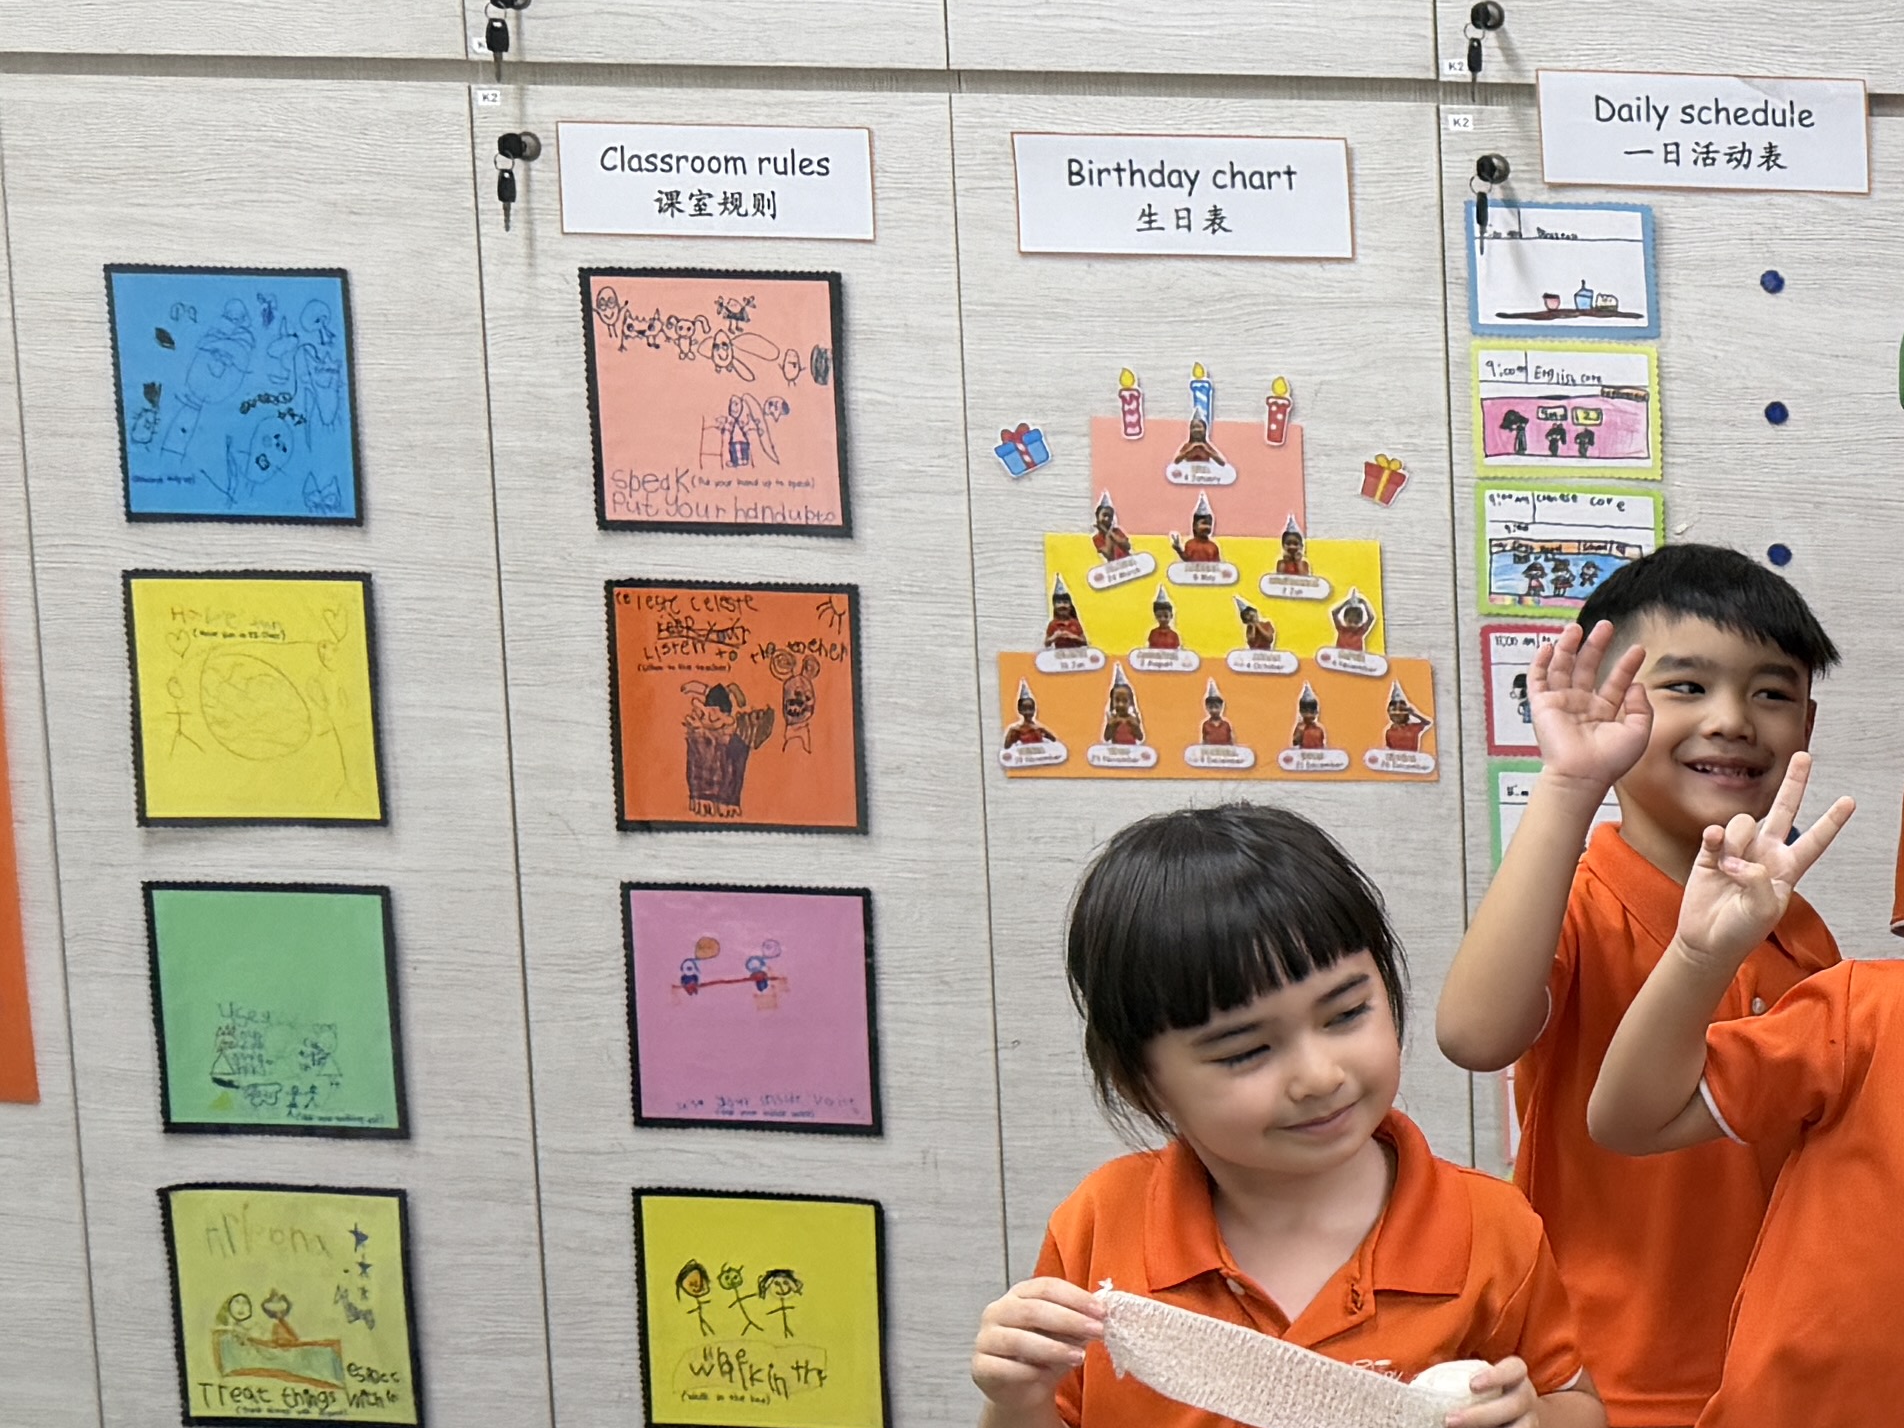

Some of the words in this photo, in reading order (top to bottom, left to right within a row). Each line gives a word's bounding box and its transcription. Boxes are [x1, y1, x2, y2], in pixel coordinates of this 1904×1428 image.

[1594, 94, 1669, 131] Daily
[1680, 97, 1815, 129] schedule
[600, 145, 747, 175] Classroom
[758, 148, 830, 177] rules
[1623, 140, 1788, 172] 一日活动表
[1067, 158, 1200, 196] Birthday
[1212, 161, 1297, 190] chart
[653, 188, 777, 220] 课室规则
[1136, 203, 1232, 235] 生日表
